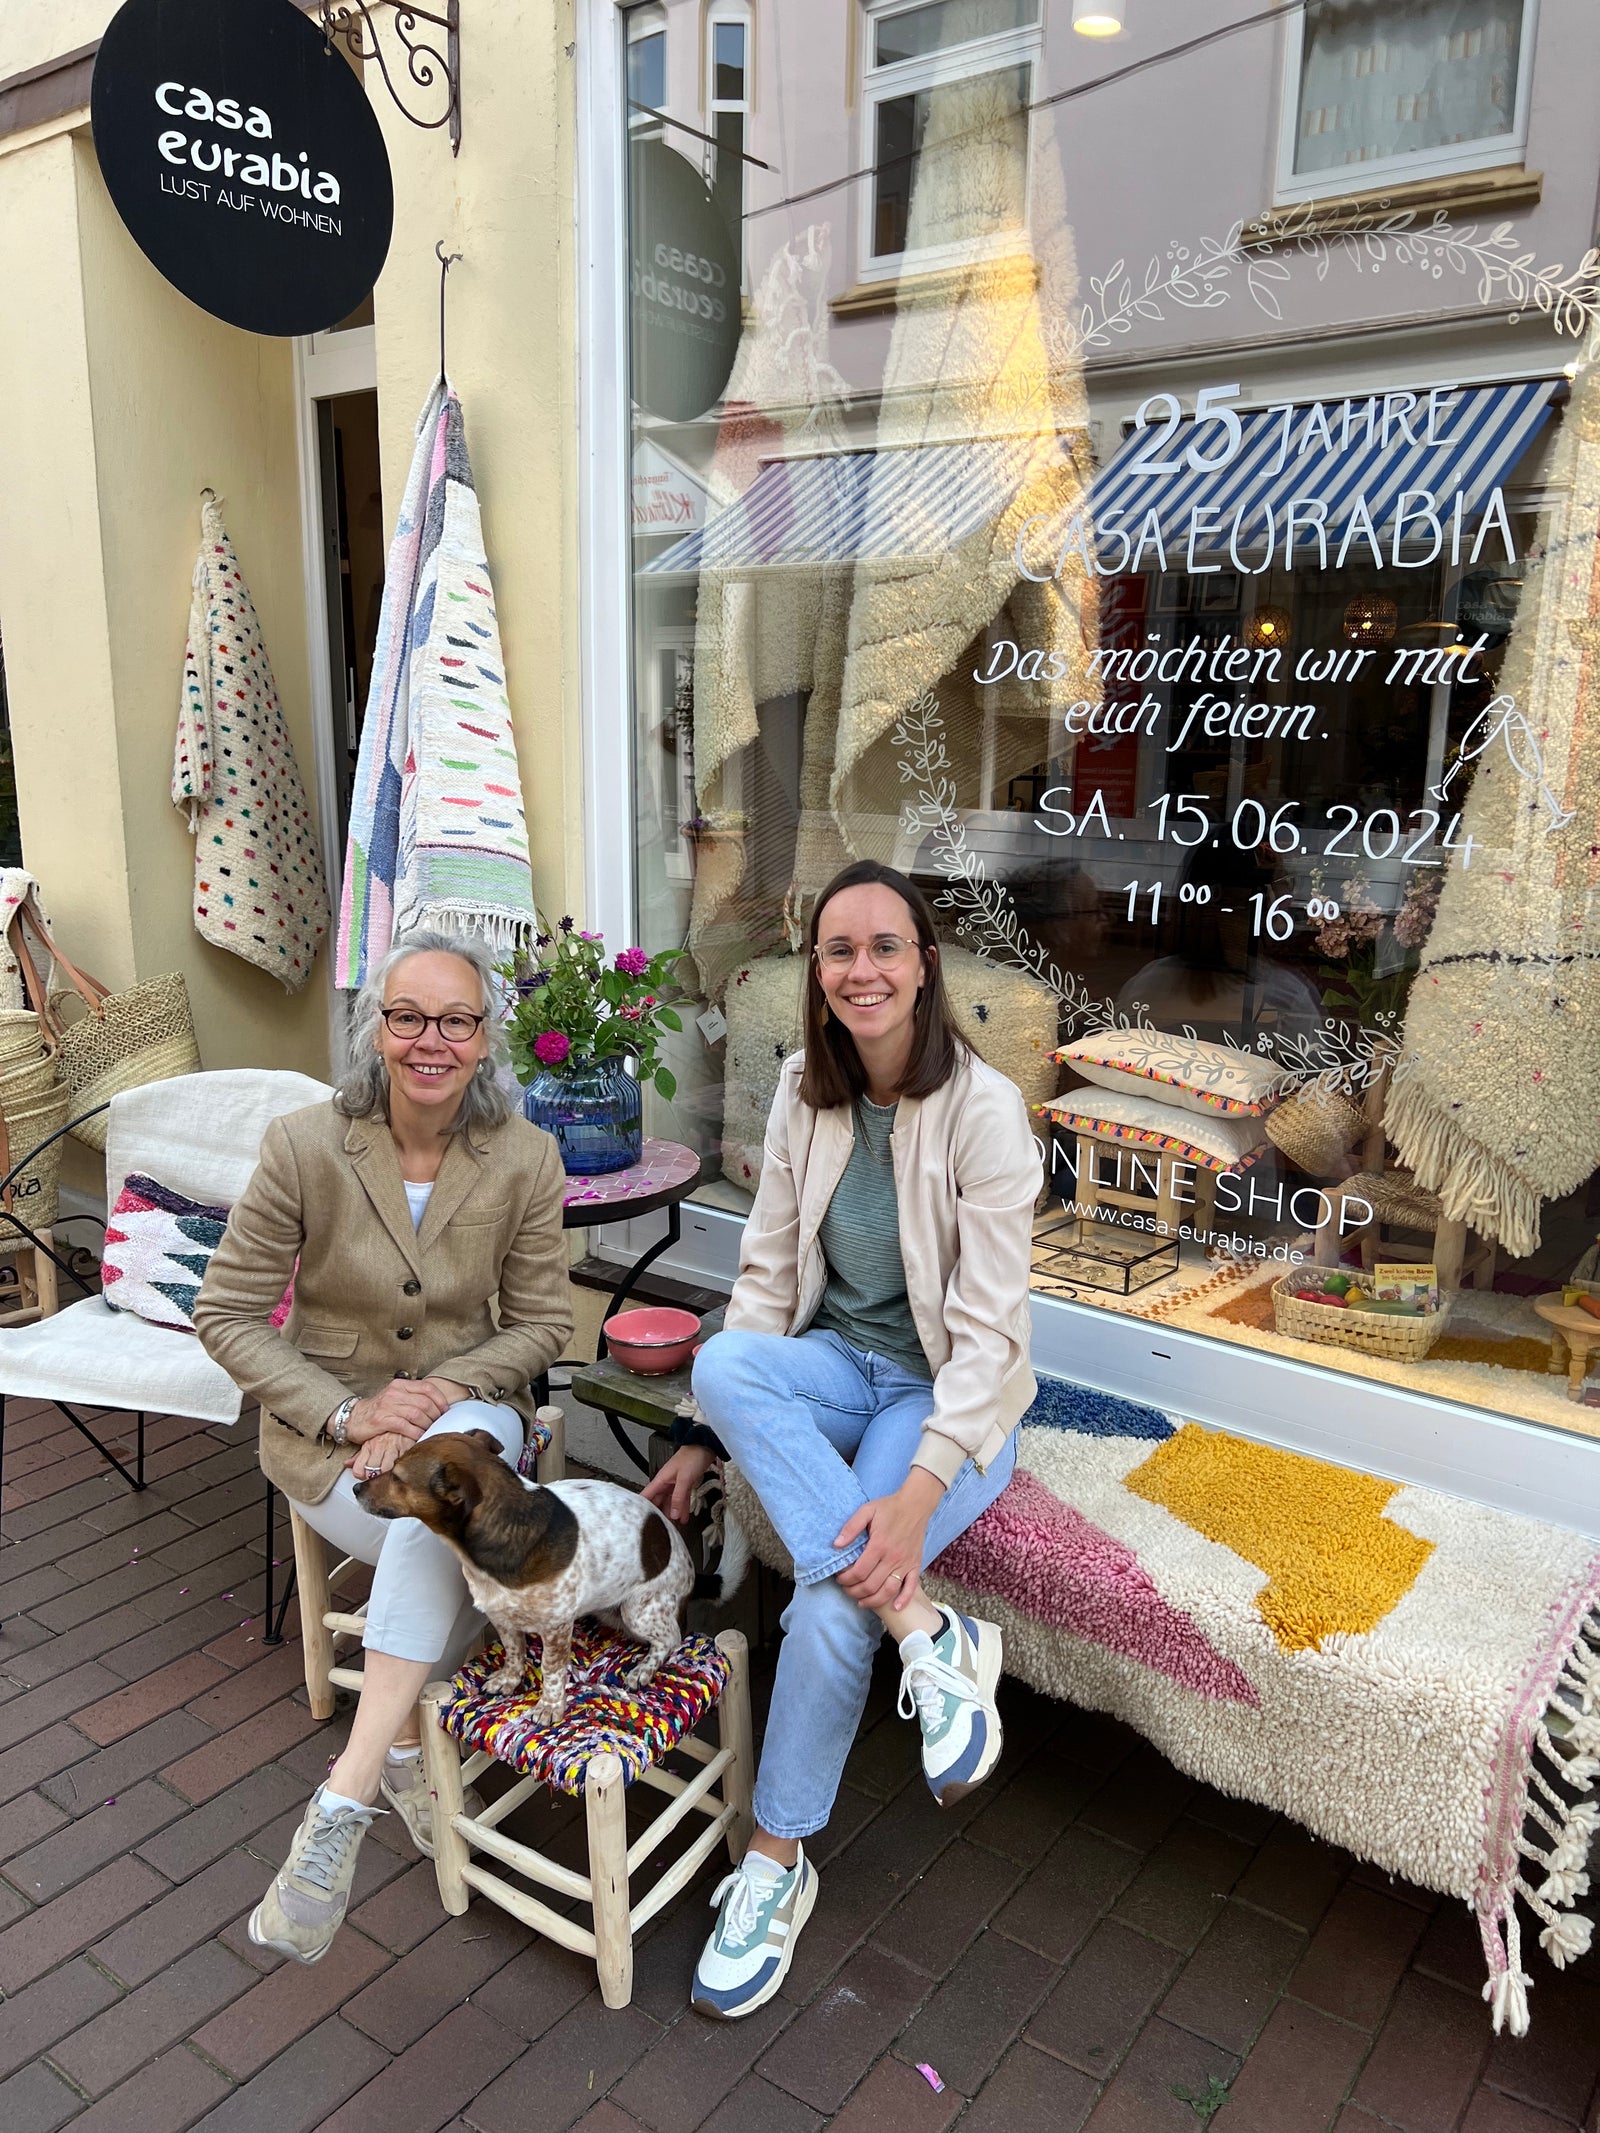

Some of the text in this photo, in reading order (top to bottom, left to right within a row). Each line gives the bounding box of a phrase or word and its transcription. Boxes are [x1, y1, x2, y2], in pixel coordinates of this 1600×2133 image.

[154, 82, 274, 139] casa
[157, 130, 341, 206] eurabia
[160, 173, 343, 236] LUST AUF WOHNEN
[1129, 383, 1460, 478] 25 JAHRE
[1015, 507, 1168, 583] CASA
[972, 632, 1490, 686] Das möchten wir mit
[1063, 692, 1329, 753] euch feiern.
[1033, 786, 1125, 841] SA.
[1148, 793, 1485, 870] 15.06.2024
[1061, 1197, 1305, 1267] www.casa-eurabia.de
[1213, 1171, 1375, 1236] SHOP
